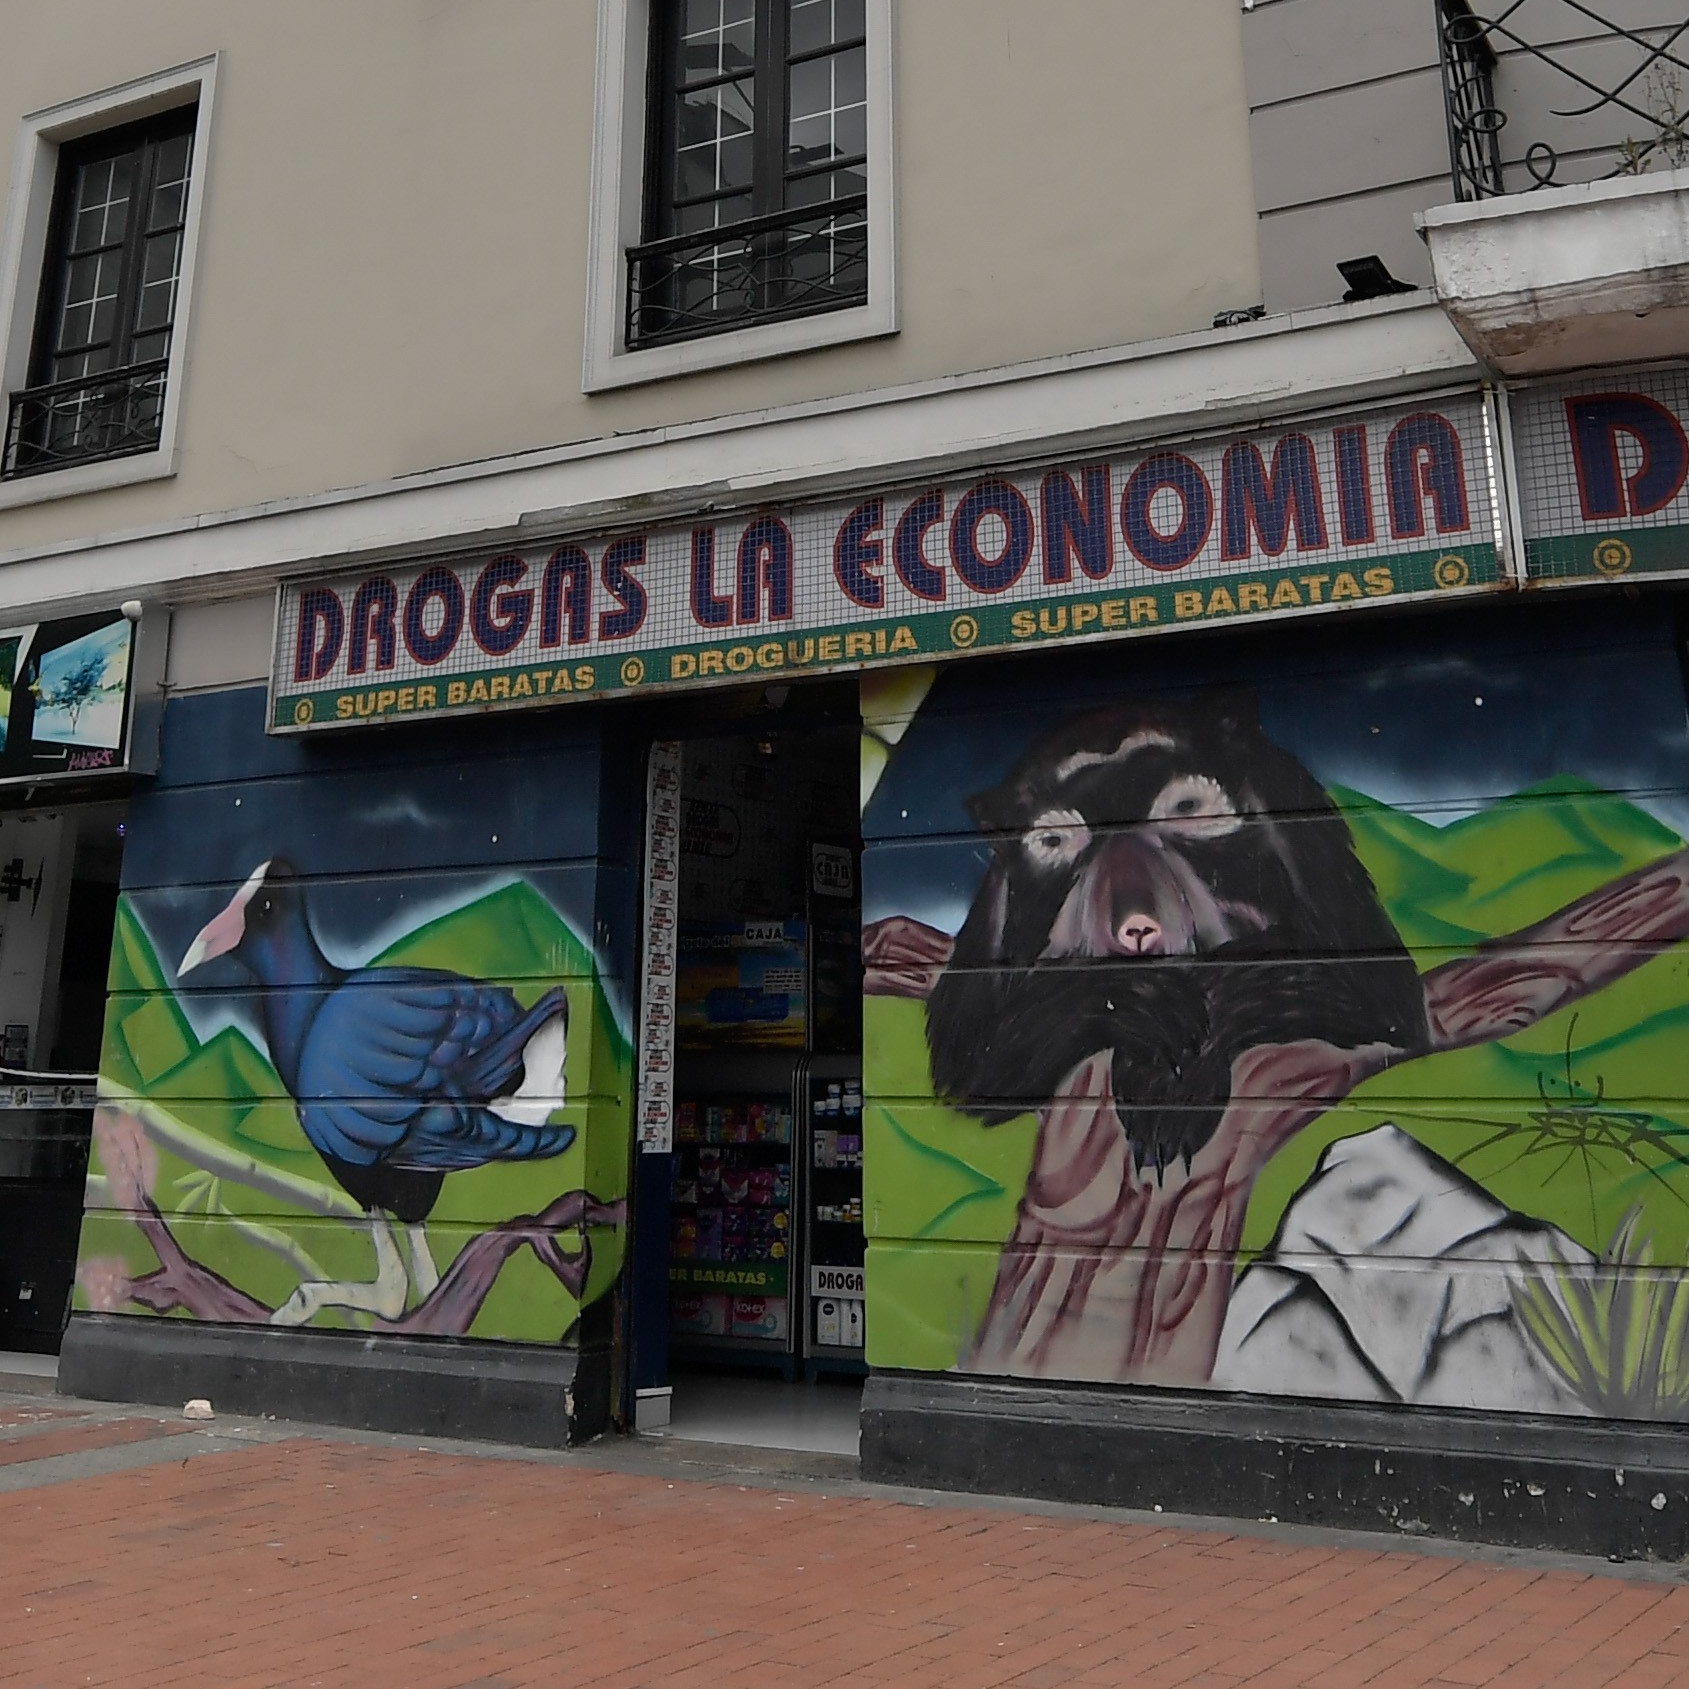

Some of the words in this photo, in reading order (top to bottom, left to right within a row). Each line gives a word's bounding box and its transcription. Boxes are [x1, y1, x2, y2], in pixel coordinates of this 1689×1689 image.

[294, 534, 648, 683] DROGAS
[690, 515, 793, 628] LA
[833, 411, 1471, 609] ECONOMIA
[336, 685, 437, 719] SUPER
[447, 665, 595, 705] BARATAS
[670, 625, 919, 680] DROGUERIA
[1011, 595, 1159, 639] SUPER
[1174, 567, 1395, 619] BARATAS
[746, 927, 783, 940] CAJA
[693, 1269, 767, 1285] BARATAS
